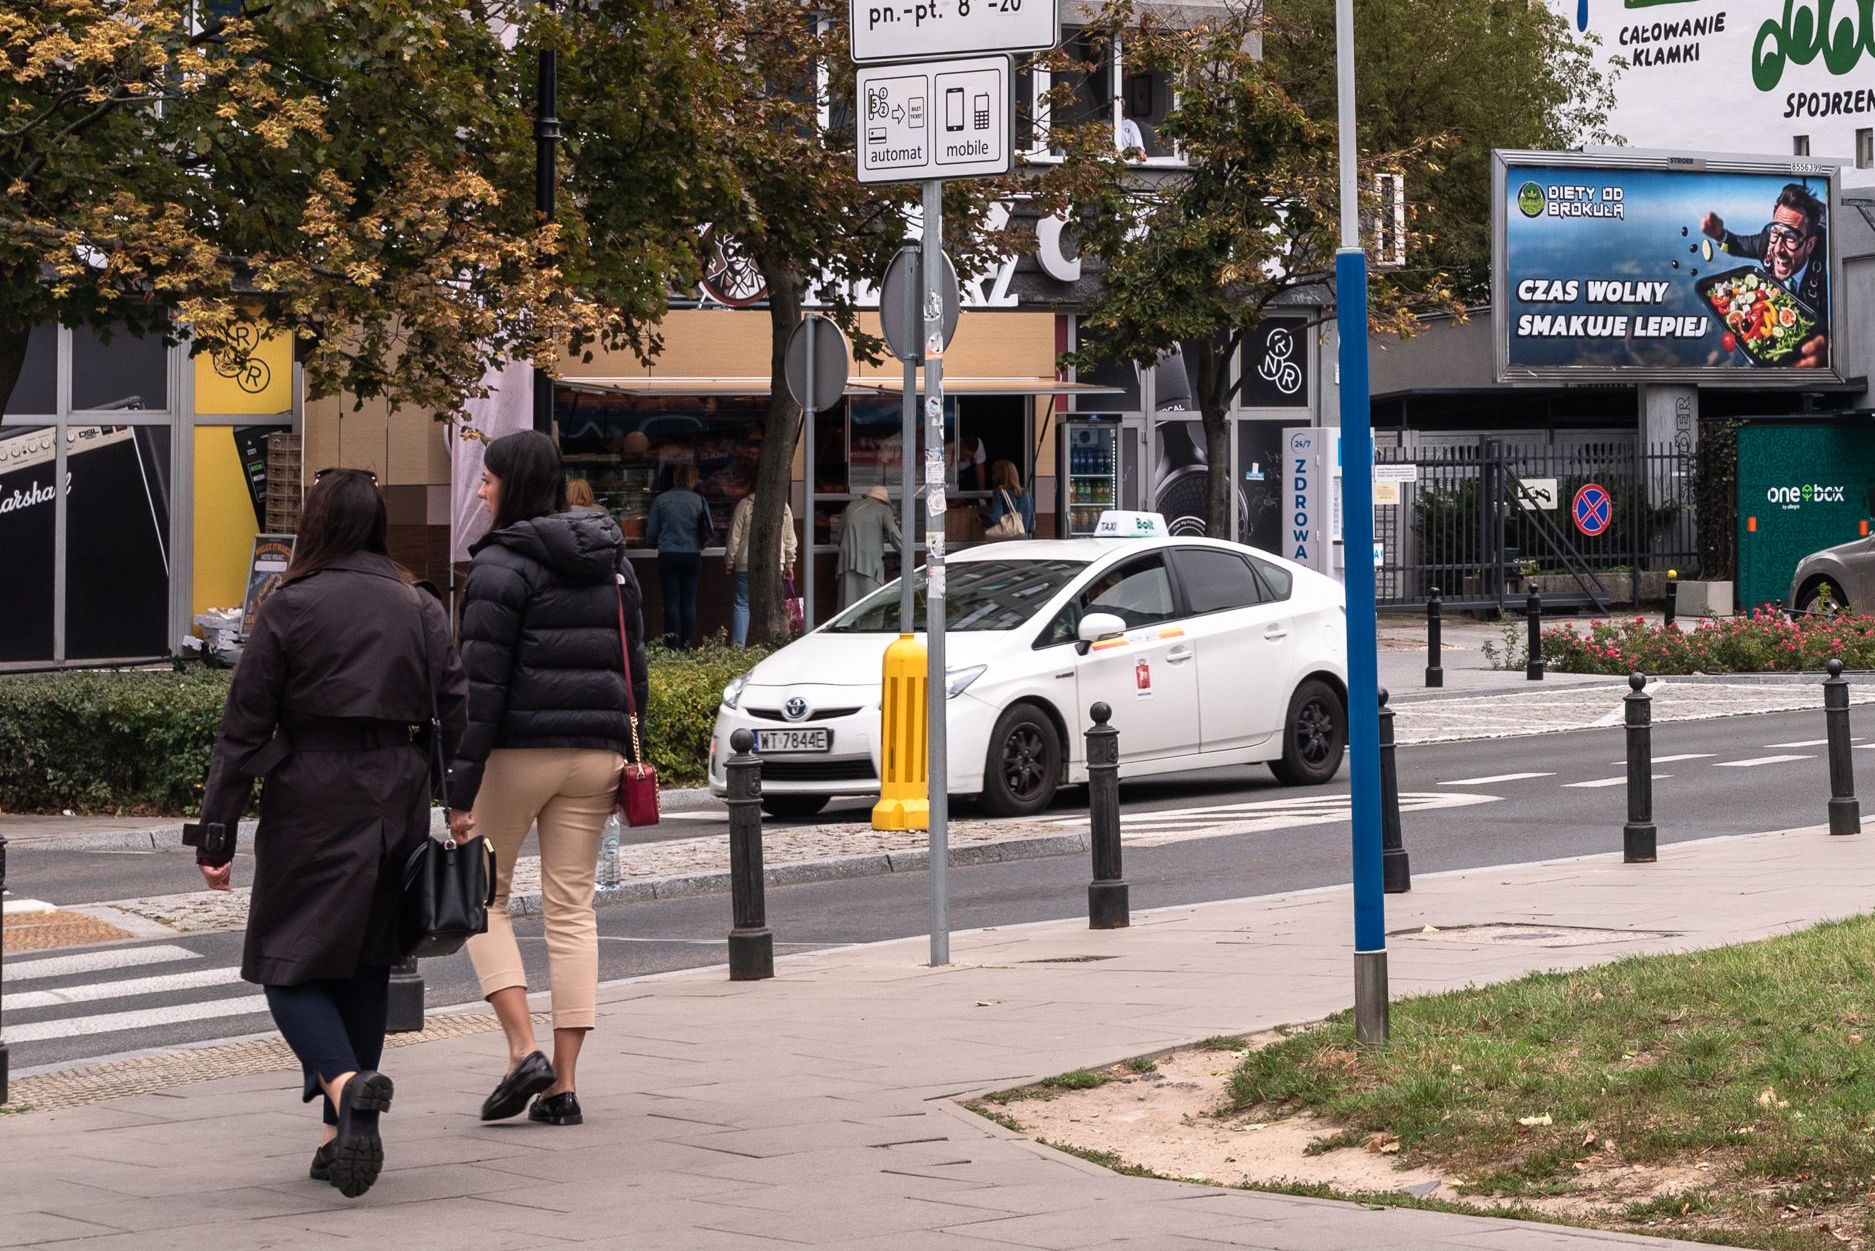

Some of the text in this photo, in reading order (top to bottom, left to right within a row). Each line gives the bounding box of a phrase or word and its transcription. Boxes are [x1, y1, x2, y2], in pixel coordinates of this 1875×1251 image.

[1619, 12, 1727, 46] CAŁOWANIE
[1632, 42, 1700, 67] KLAMKI
[871, 146, 922, 162] automat
[946, 140, 989, 157] mobile
[1791, 162, 1823, 172] 8556399
[1548, 185, 1624, 202] DIETY OD
[1548, 202, 1624, 220] BROKUŁA
[1518, 279, 1670, 304] CZAS WOLNY
[1518, 315, 1708, 338] SMAKUJE LEPIEJ
[1295, 440, 1311, 448] 24/7
[1101, 518, 1154, 531] TAXI Bolt
[783, 731, 825, 749] 7844E
